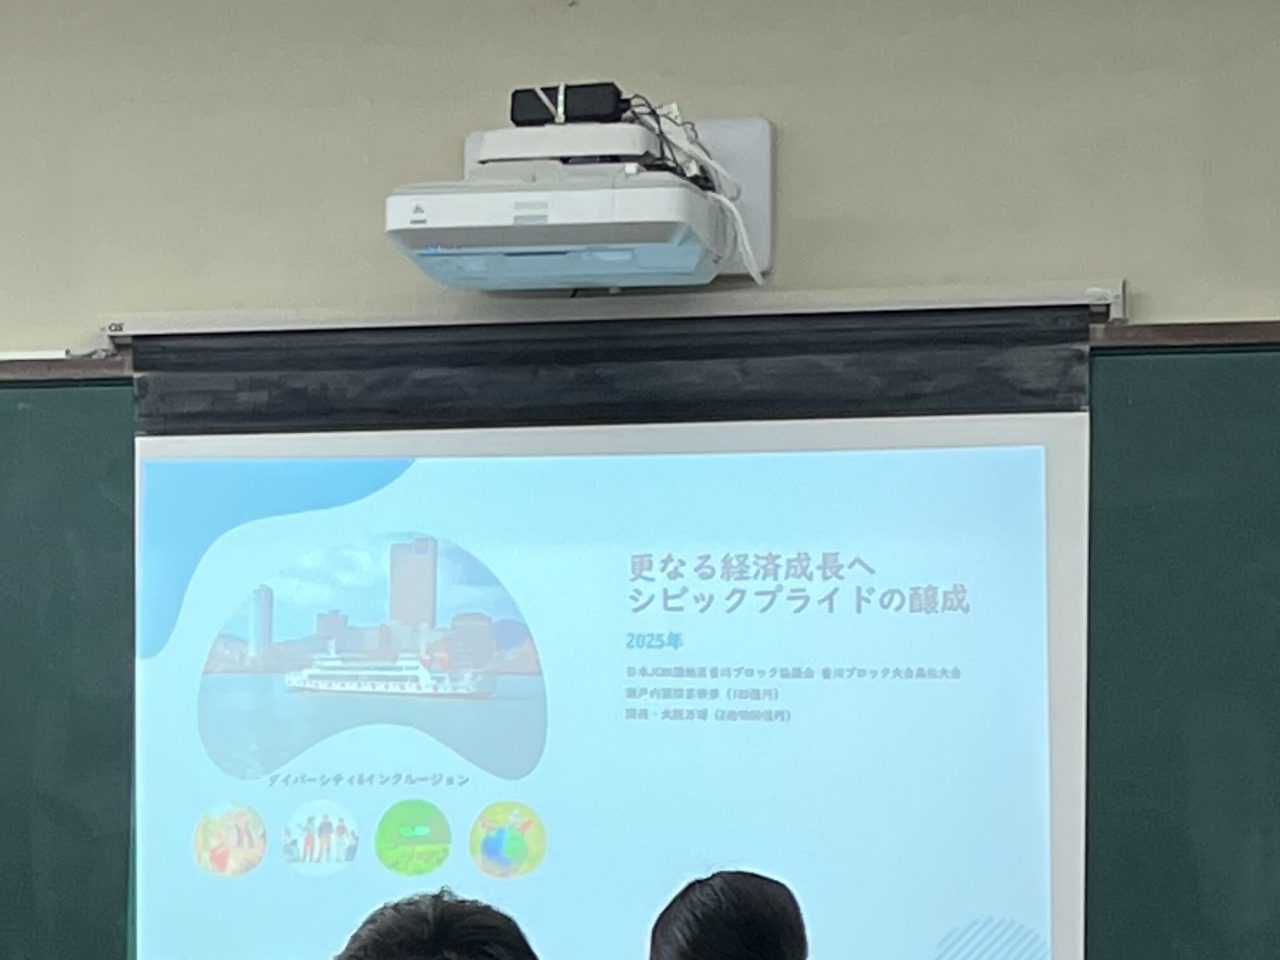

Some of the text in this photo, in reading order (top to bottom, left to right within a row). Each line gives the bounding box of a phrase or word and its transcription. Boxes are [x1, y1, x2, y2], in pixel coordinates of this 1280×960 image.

[629, 551, 877, 583] 更なる経済成長へ
[625, 631, 684, 651] 2025年
